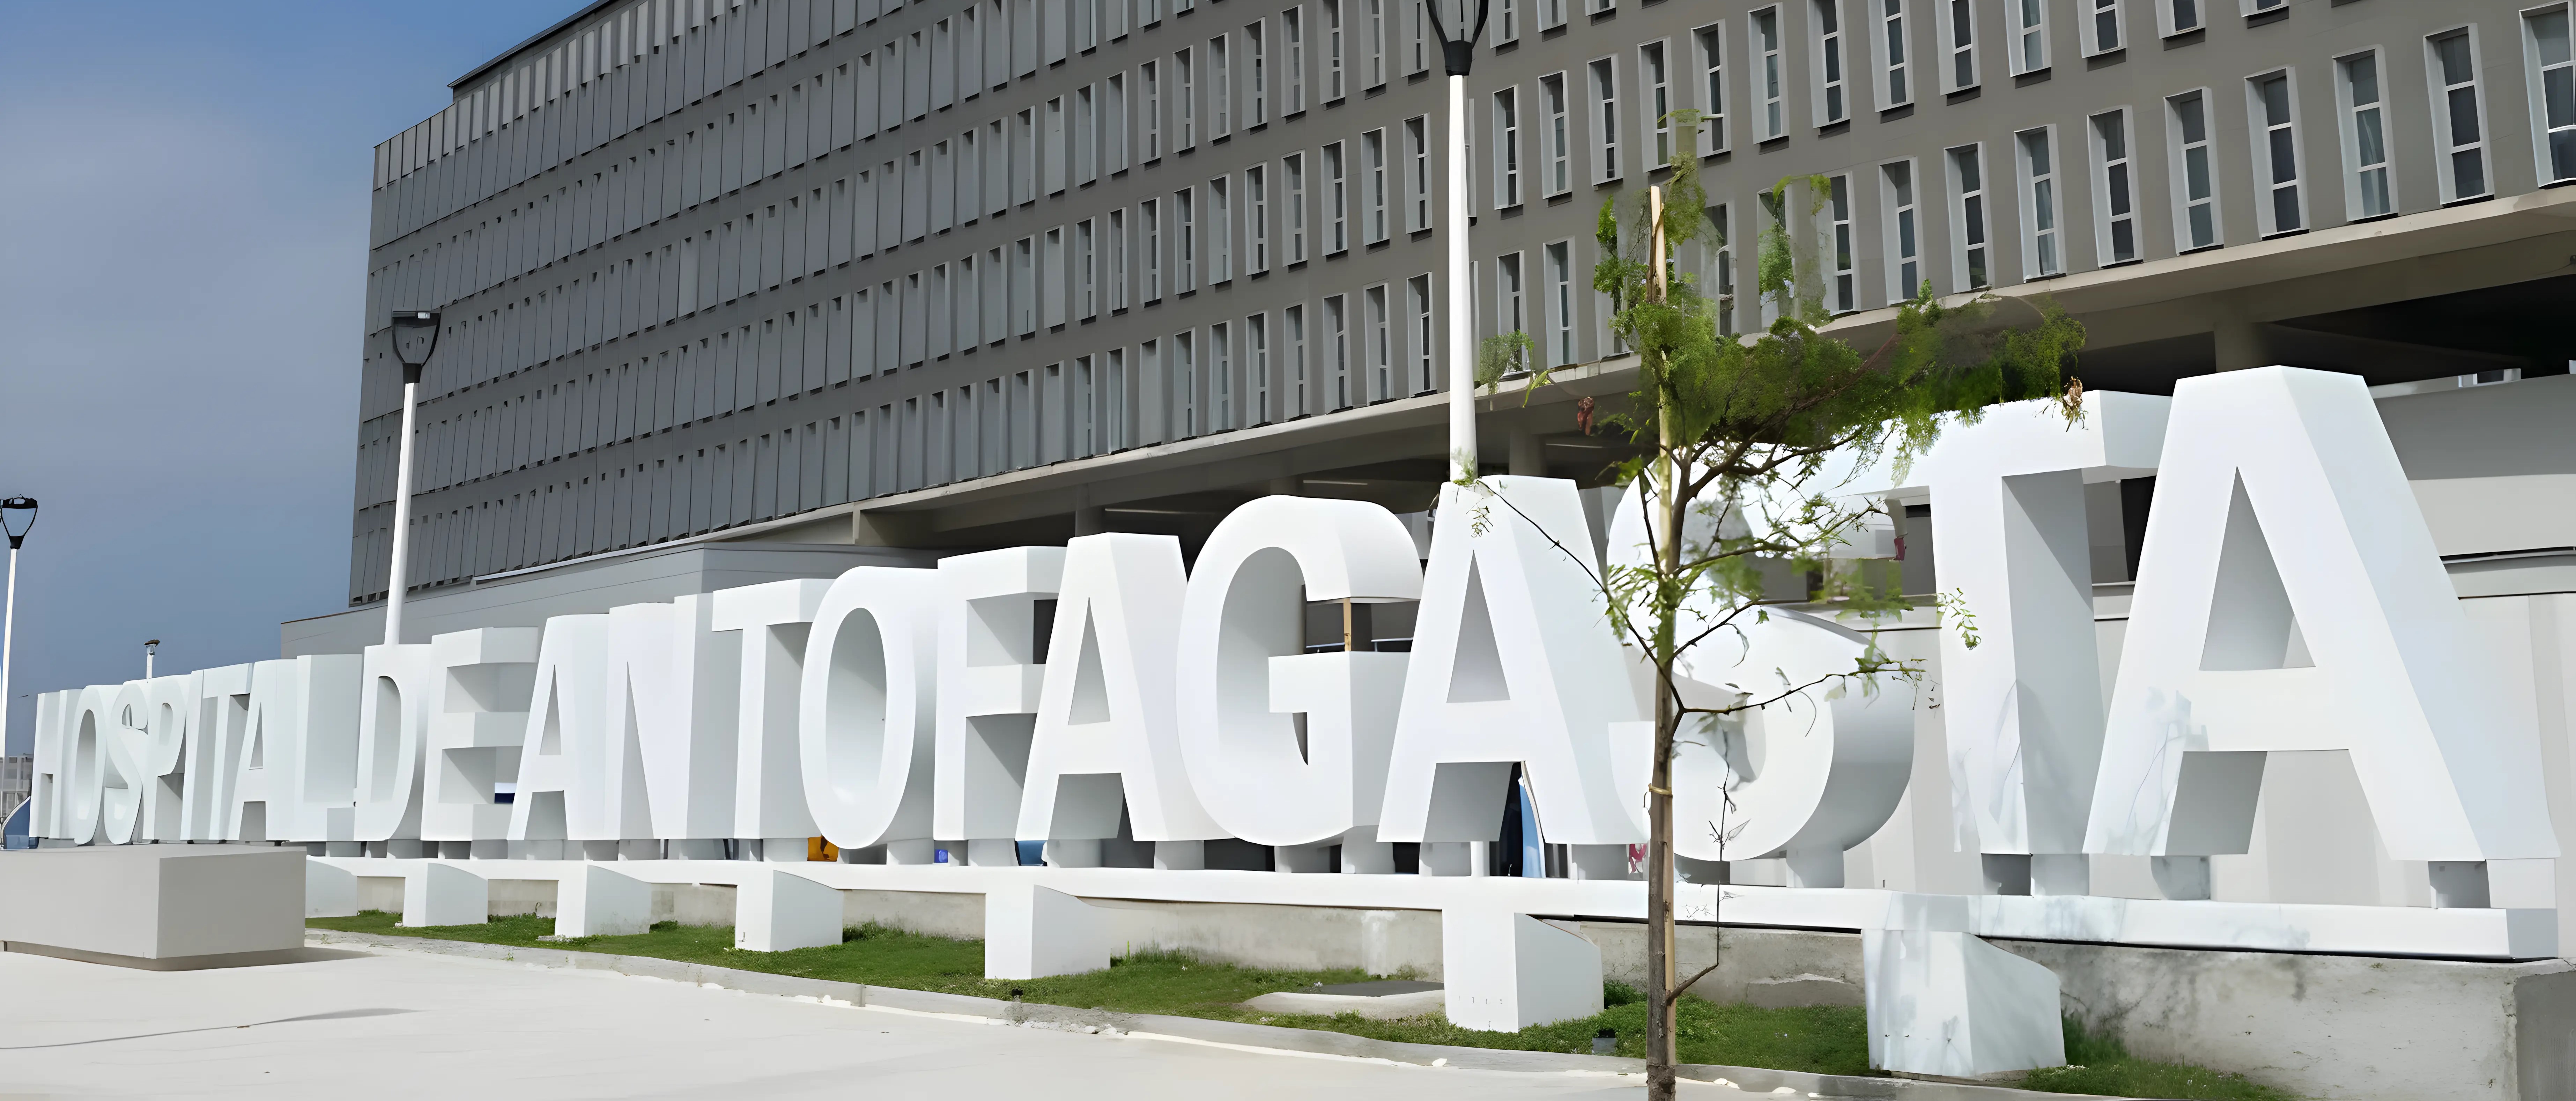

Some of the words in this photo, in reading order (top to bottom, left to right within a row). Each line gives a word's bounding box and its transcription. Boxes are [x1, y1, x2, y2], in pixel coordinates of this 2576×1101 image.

[29, 654, 362, 846] HOSPITAL
[353, 626, 538, 841] DE
[507, 364, 2559, 862] ANTOFAGASTA
